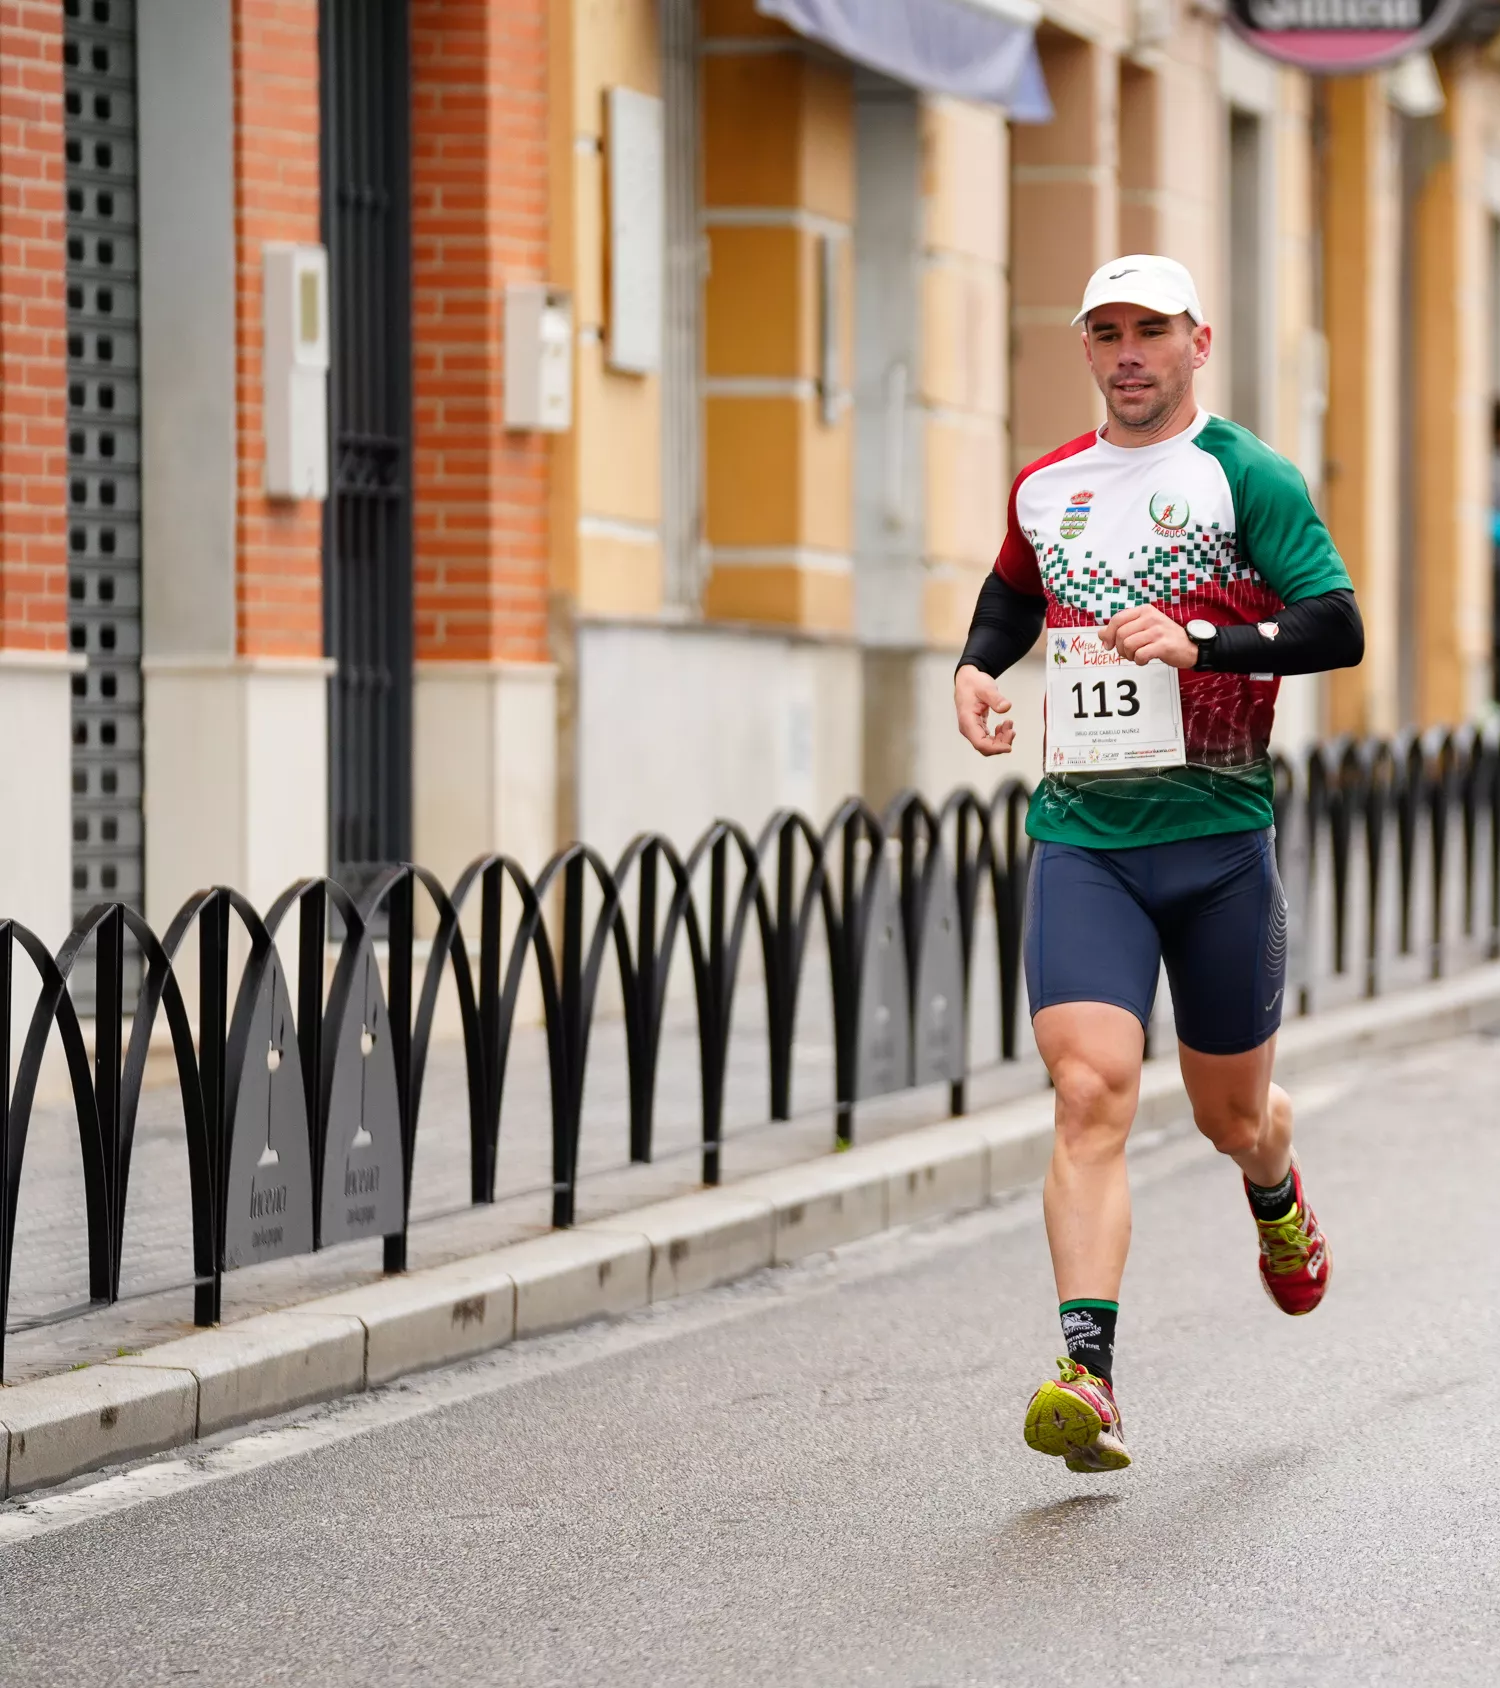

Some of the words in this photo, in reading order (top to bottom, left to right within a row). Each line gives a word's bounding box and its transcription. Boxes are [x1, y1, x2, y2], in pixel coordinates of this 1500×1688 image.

[1152, 524, 1187, 539] TRABUCO
[1083, 651, 1122, 666] LUCENA
[1071, 679, 1141, 719] 113
[248, 1174, 287, 1221] lucena
